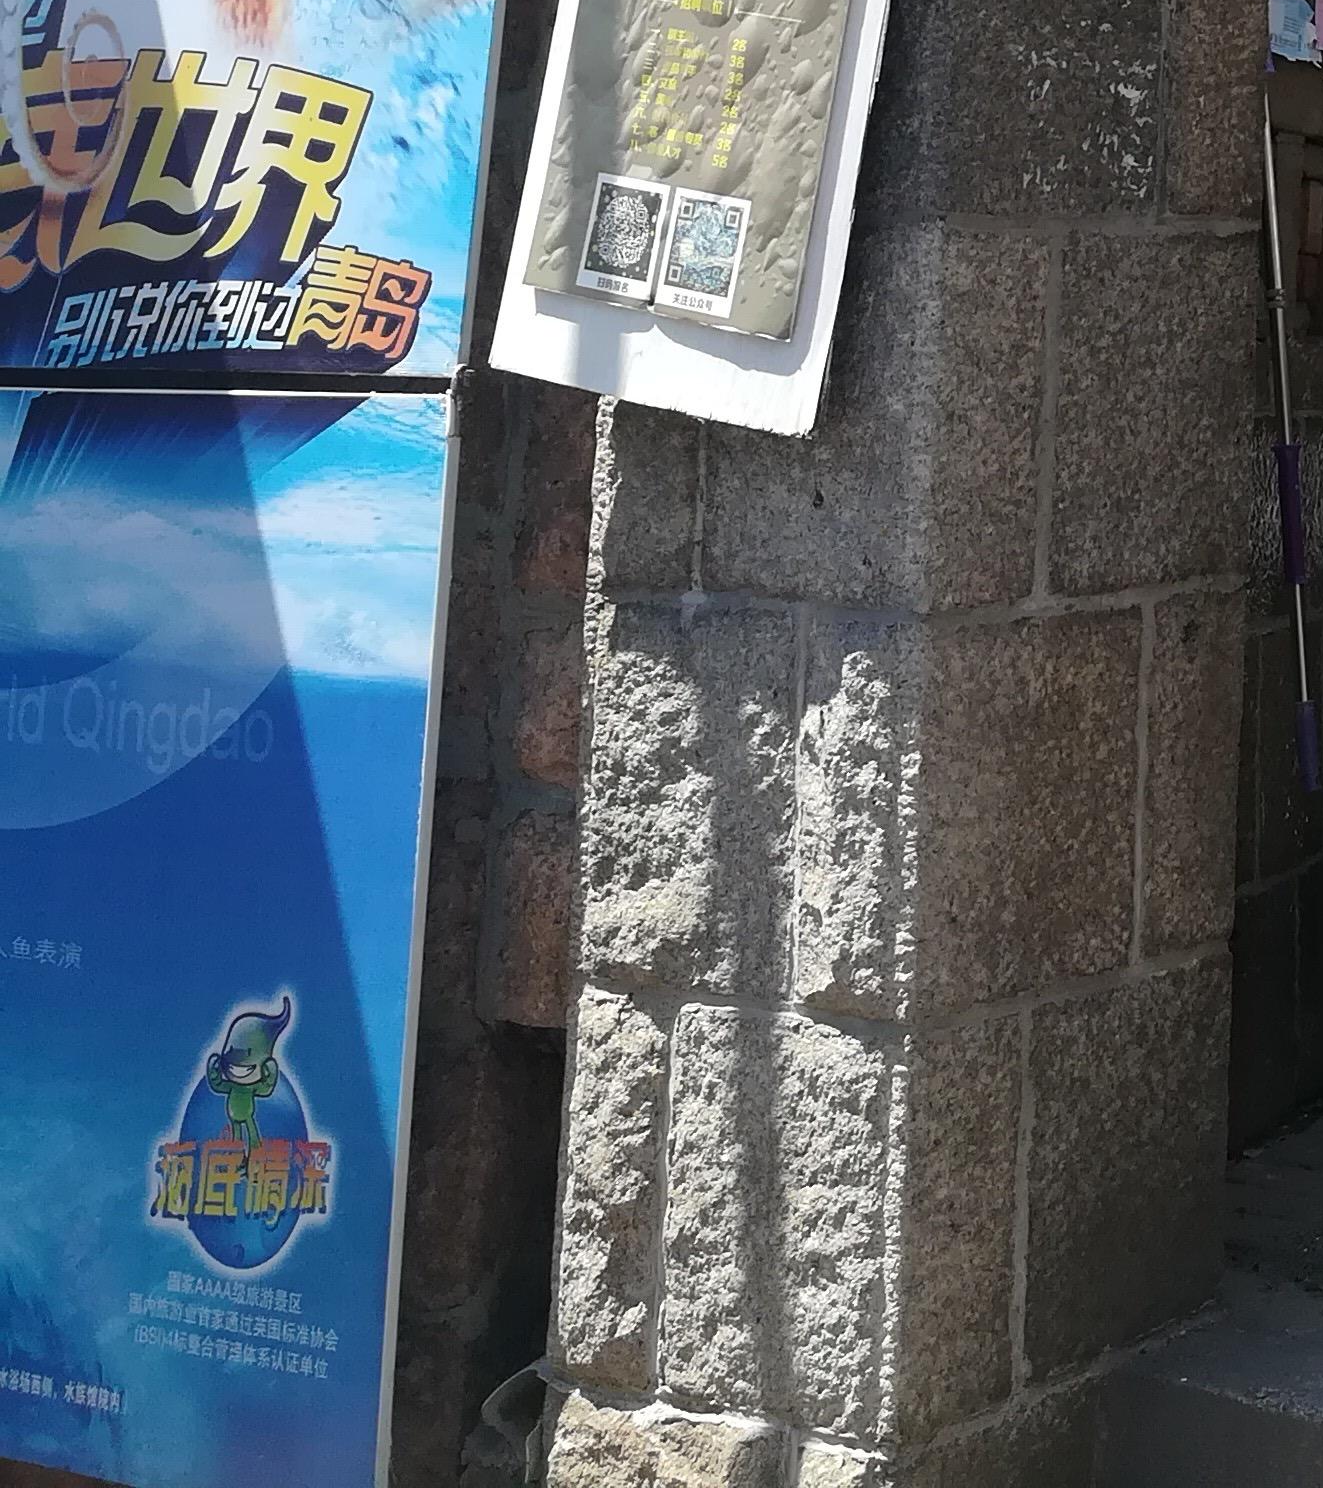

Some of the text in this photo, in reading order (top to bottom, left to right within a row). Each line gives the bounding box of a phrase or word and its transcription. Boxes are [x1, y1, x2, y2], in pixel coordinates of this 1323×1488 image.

[46, 247, 430, 369] 别说你到过青岛
[63, 676, 275, 774] Qingdao
